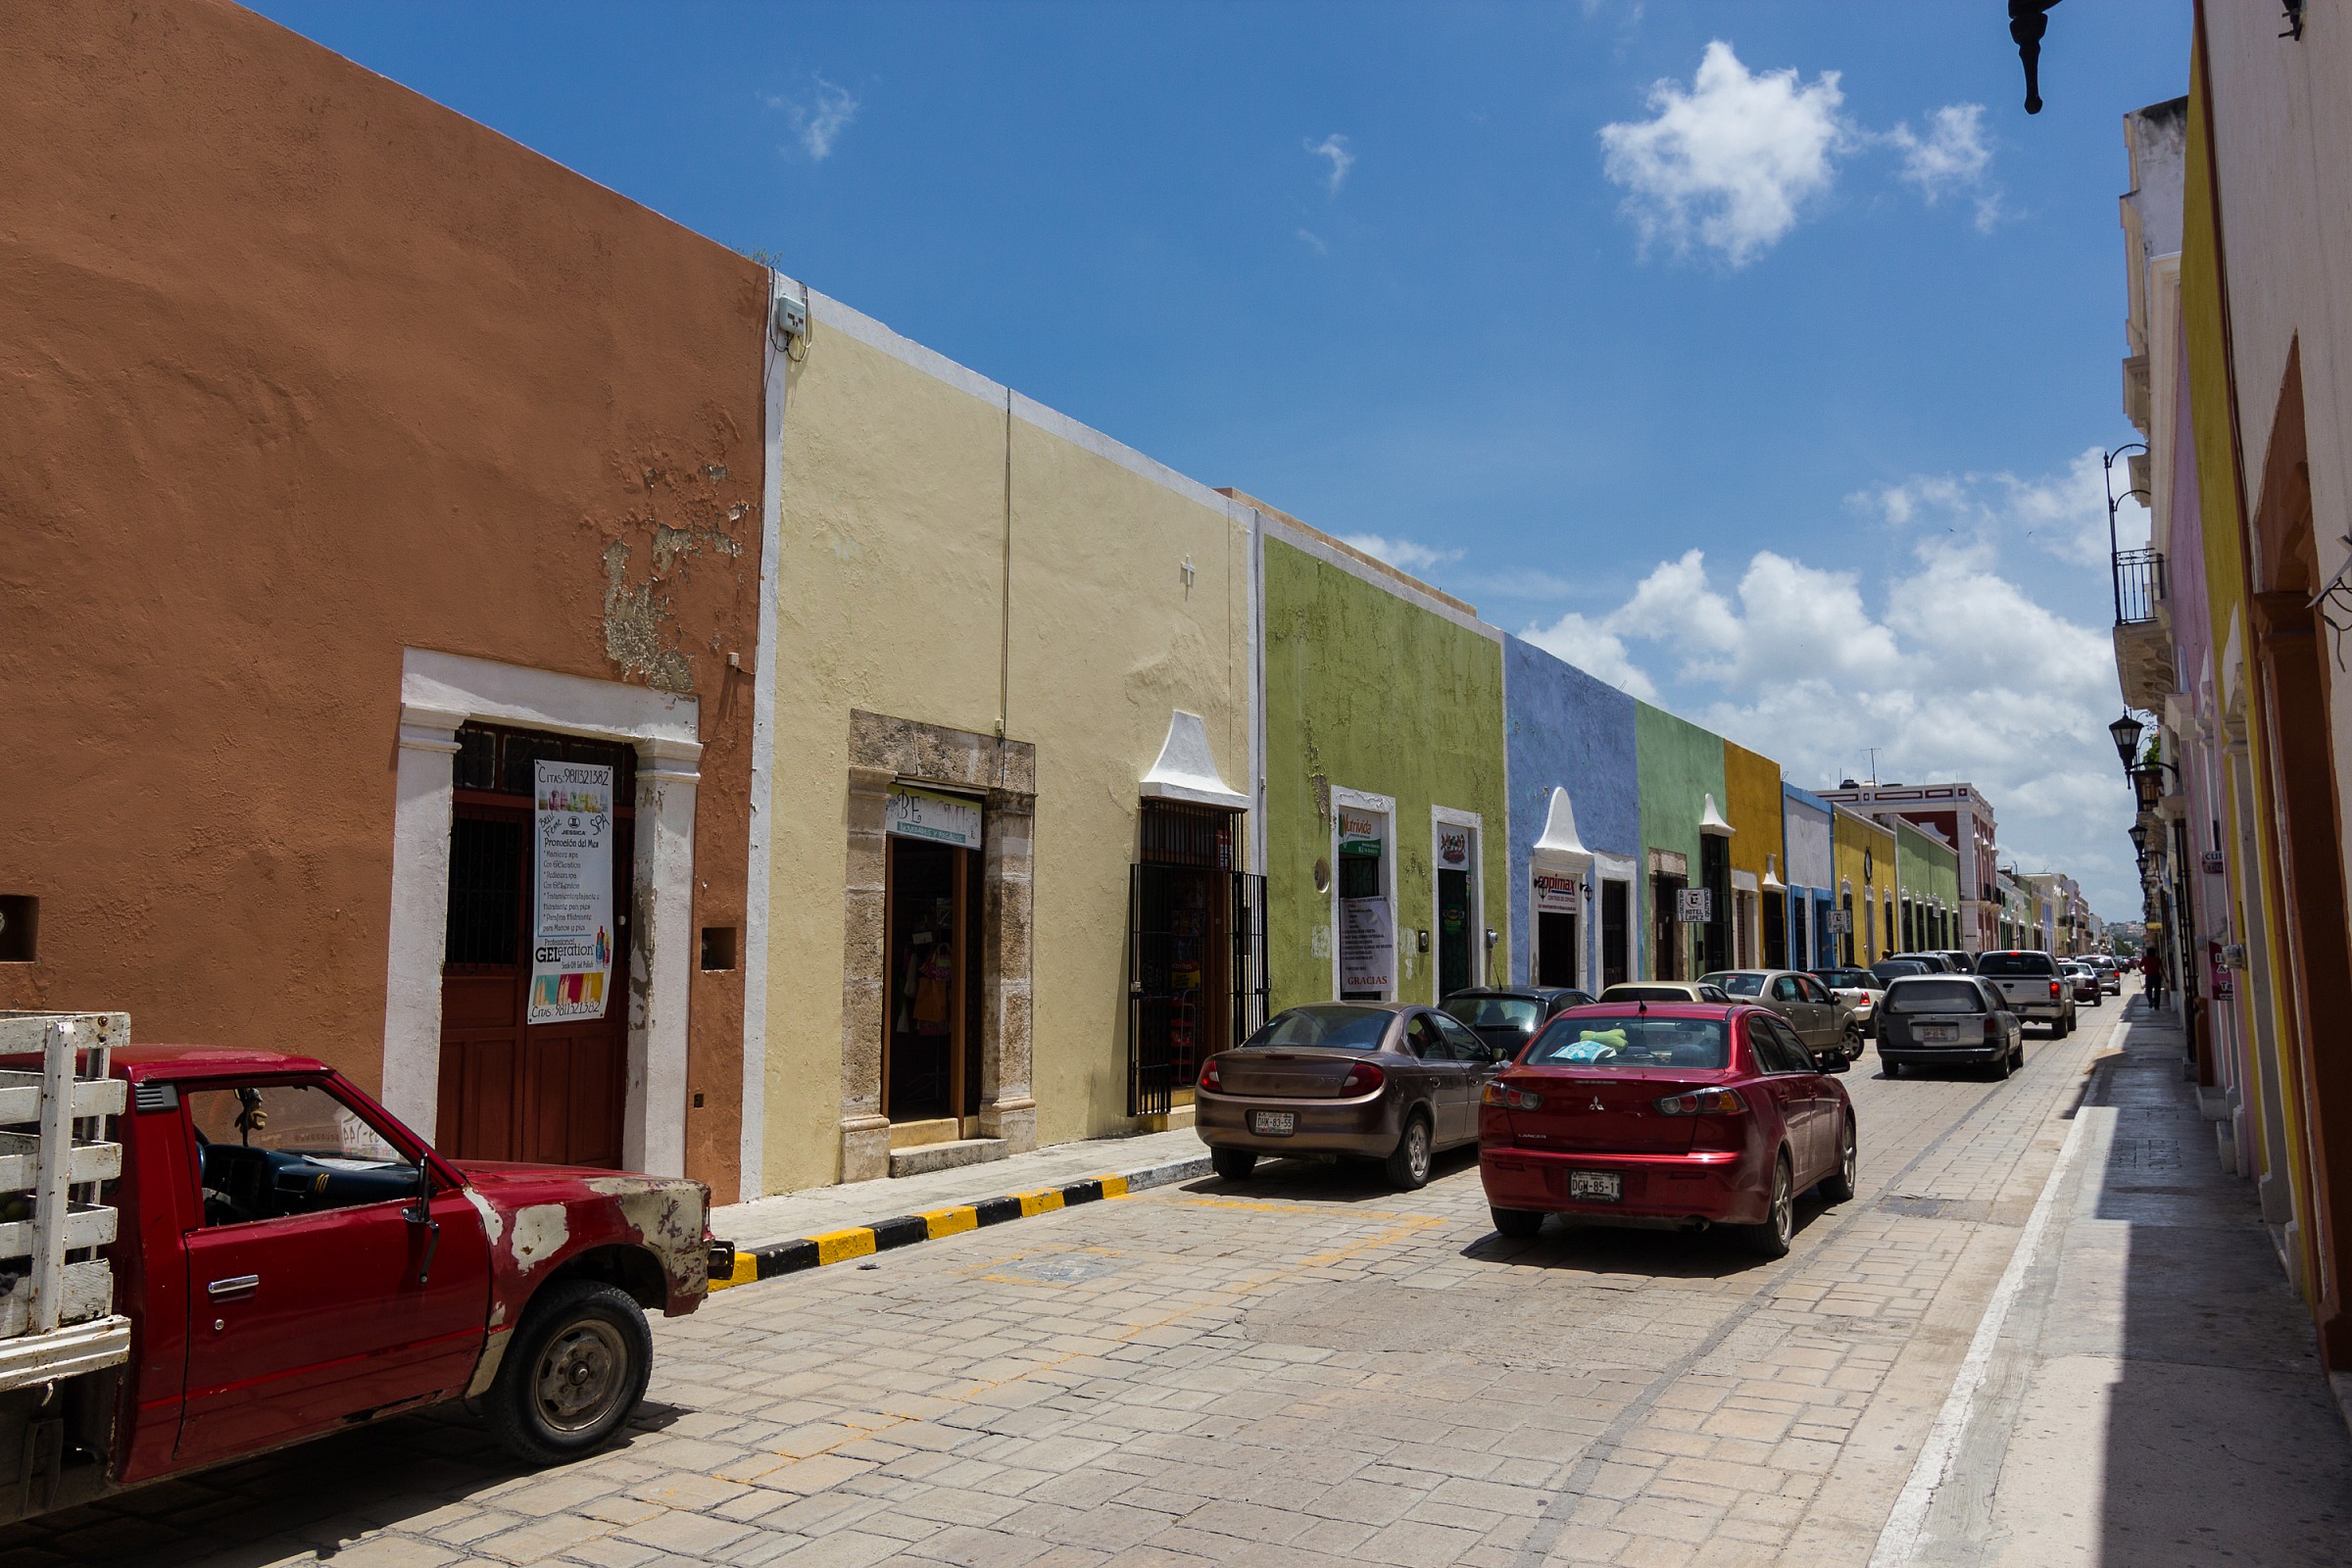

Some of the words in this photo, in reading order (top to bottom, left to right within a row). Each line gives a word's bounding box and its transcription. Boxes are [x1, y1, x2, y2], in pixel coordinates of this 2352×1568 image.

[590, 813, 610, 836] SPA
[1343, 813, 1372, 835] Nutrivida
[900, 823, 932, 837] NOVEDADES
[939, 831, 962, 842] REGALOS
[544, 838, 576, 848] Promoción
[577, 839, 587, 848] del
[588, 839, 599, 849] Mes
[543, 859, 552, 868] Con
[1348, 976, 1388, 985] GRACIAS
